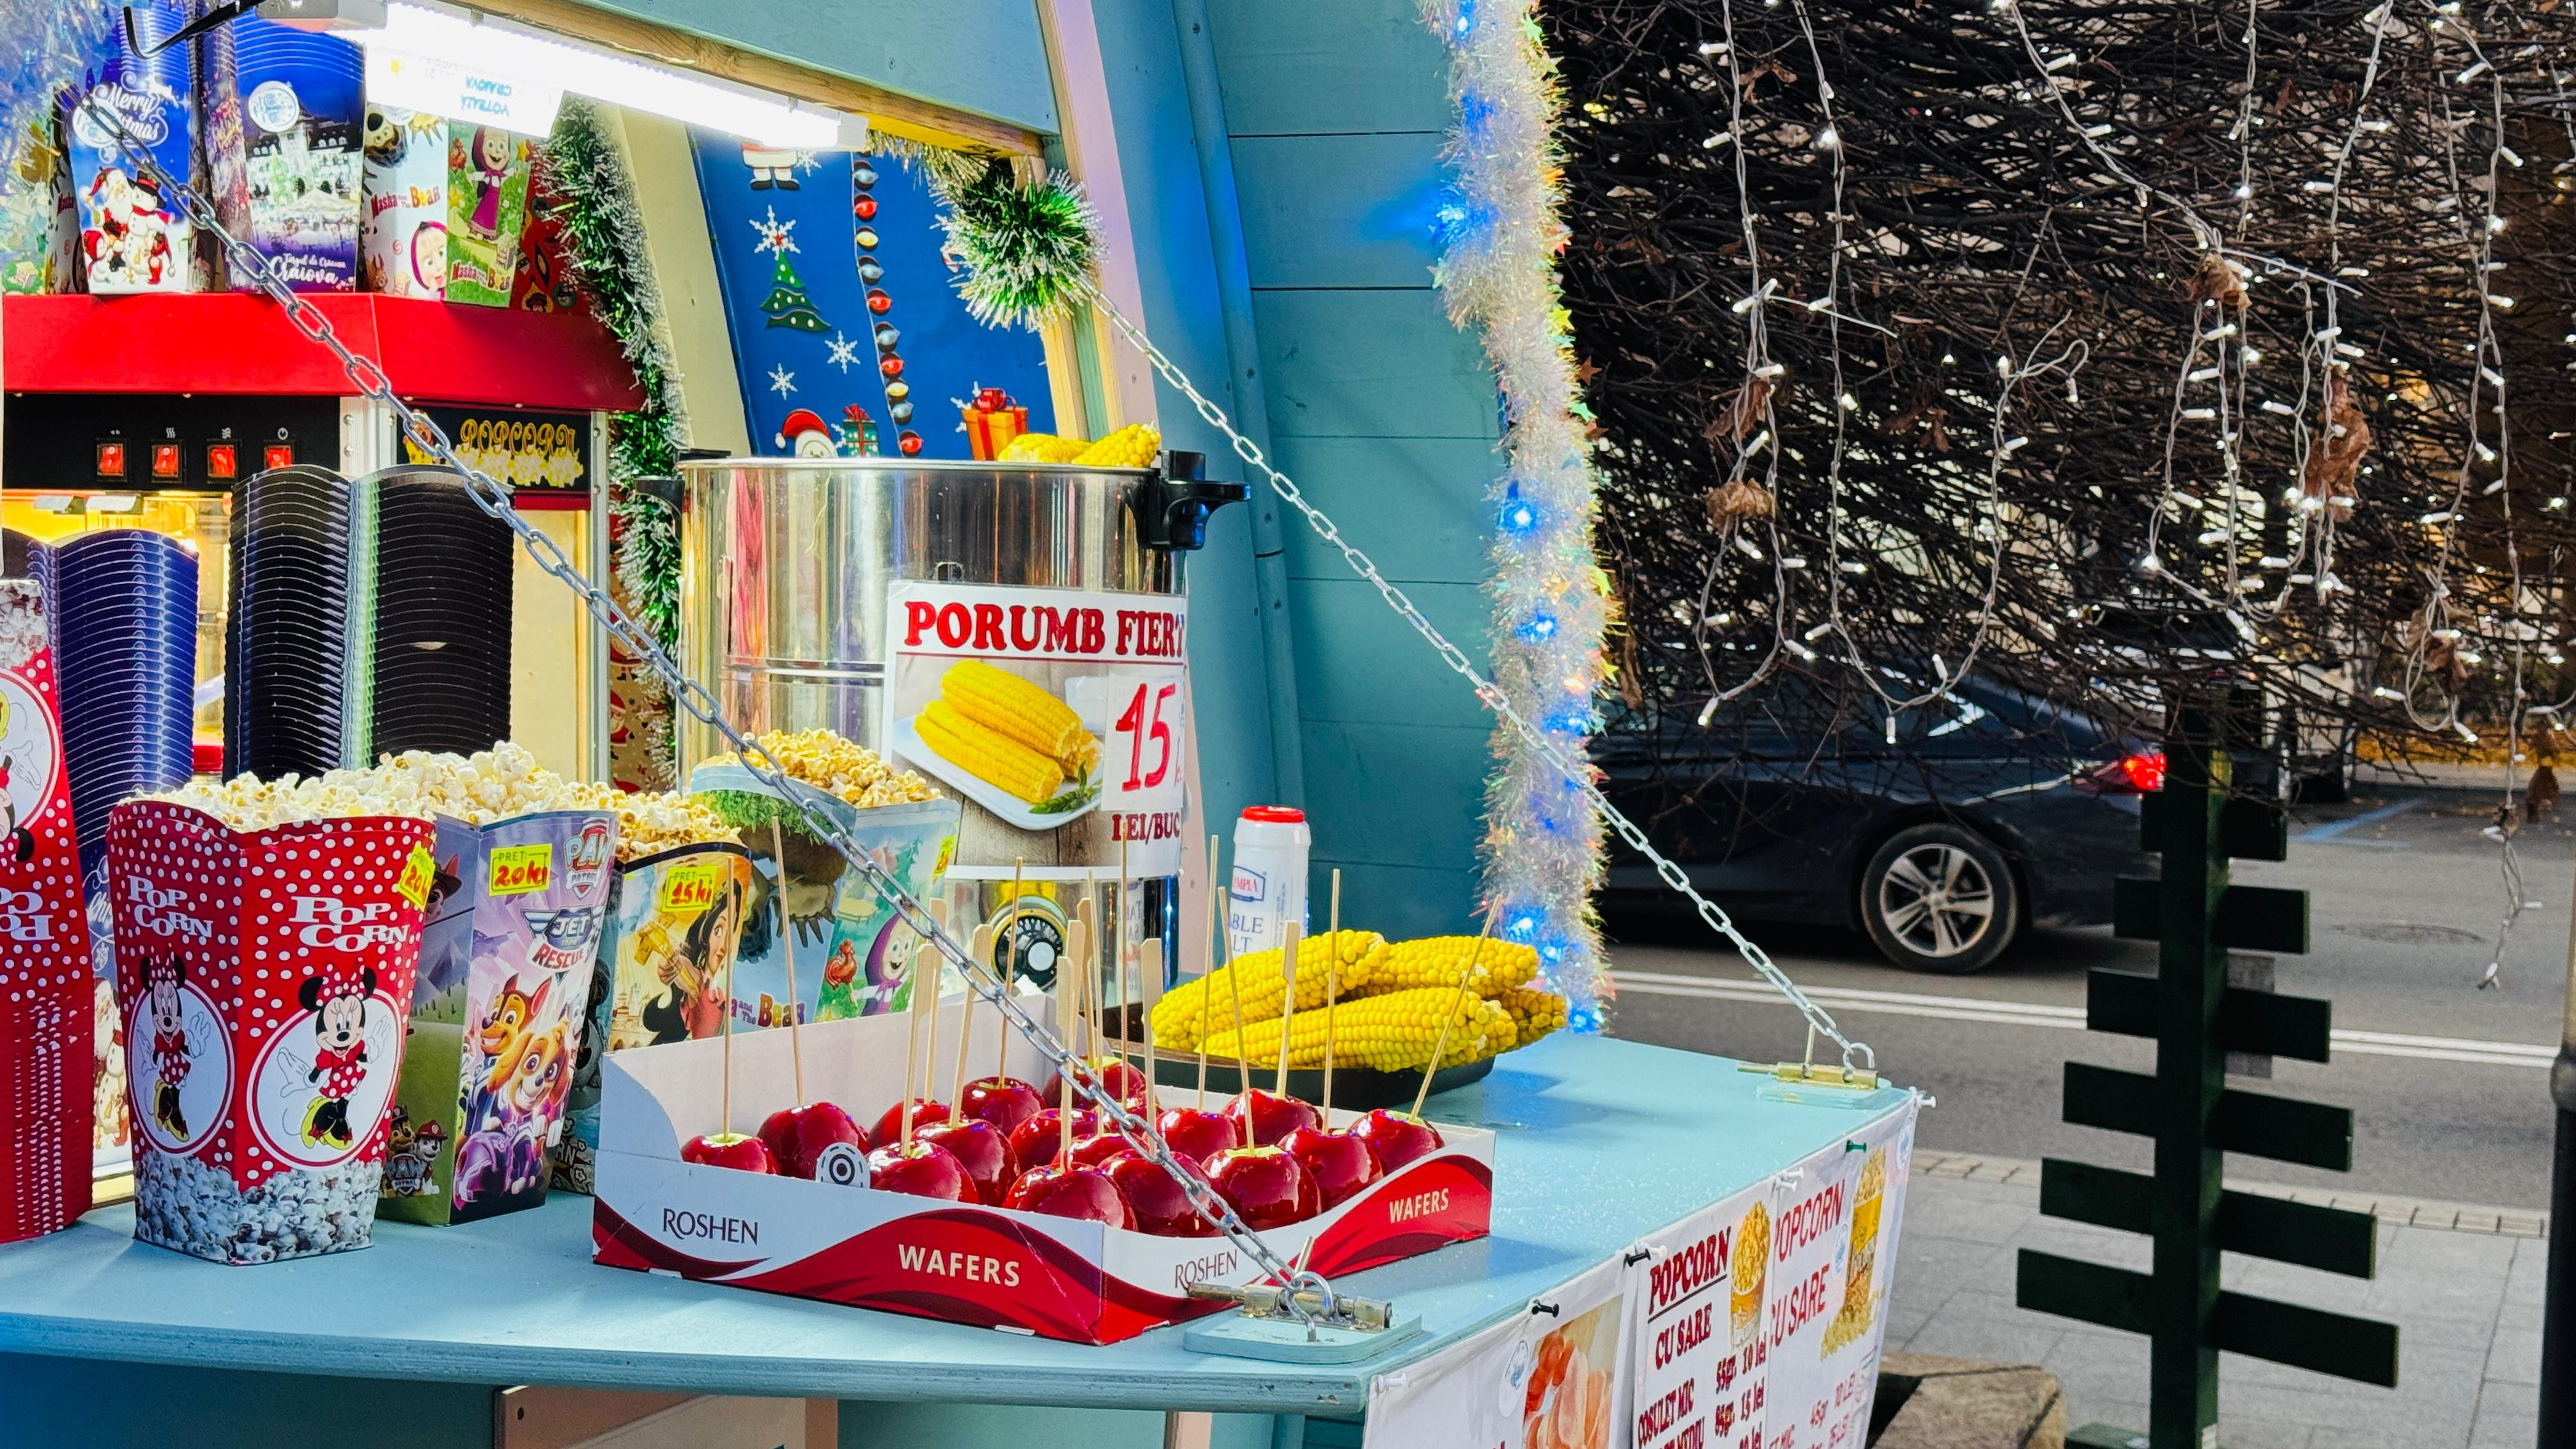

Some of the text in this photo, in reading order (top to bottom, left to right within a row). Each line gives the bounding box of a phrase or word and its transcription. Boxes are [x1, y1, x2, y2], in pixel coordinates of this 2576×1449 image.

[93, 82, 160, 121] Merry
[270, 256, 339, 284] Craiova
[460, 418, 576, 456] POPCORN
[904, 601, 1106, 654] PORUMB
[1114, 682, 1176, 793] 15
[127, 874, 187, 908] POP
[134, 903, 214, 937] CORN
[288, 896, 392, 926] POP
[553, 916, 591, 935] JET
[1232, 913, 1264, 934] BLE
[299, 924, 410, 953] CORN
[532, 943, 585, 970] RESCUE
[1233, 935, 1253, 953] LT
[1388, 1188, 1450, 1223] WAFERS
[662, 1208, 759, 1246] ROSHEN
[898, 1243, 1021, 1287] WAFERS
[1174, 1249, 1238, 1289] ROSHEN
[1649, 1225, 1732, 1315] POPCORN
[1788, 1263, 1830, 1337] SARE
[1656, 1302, 1712, 1370] CU SARE
